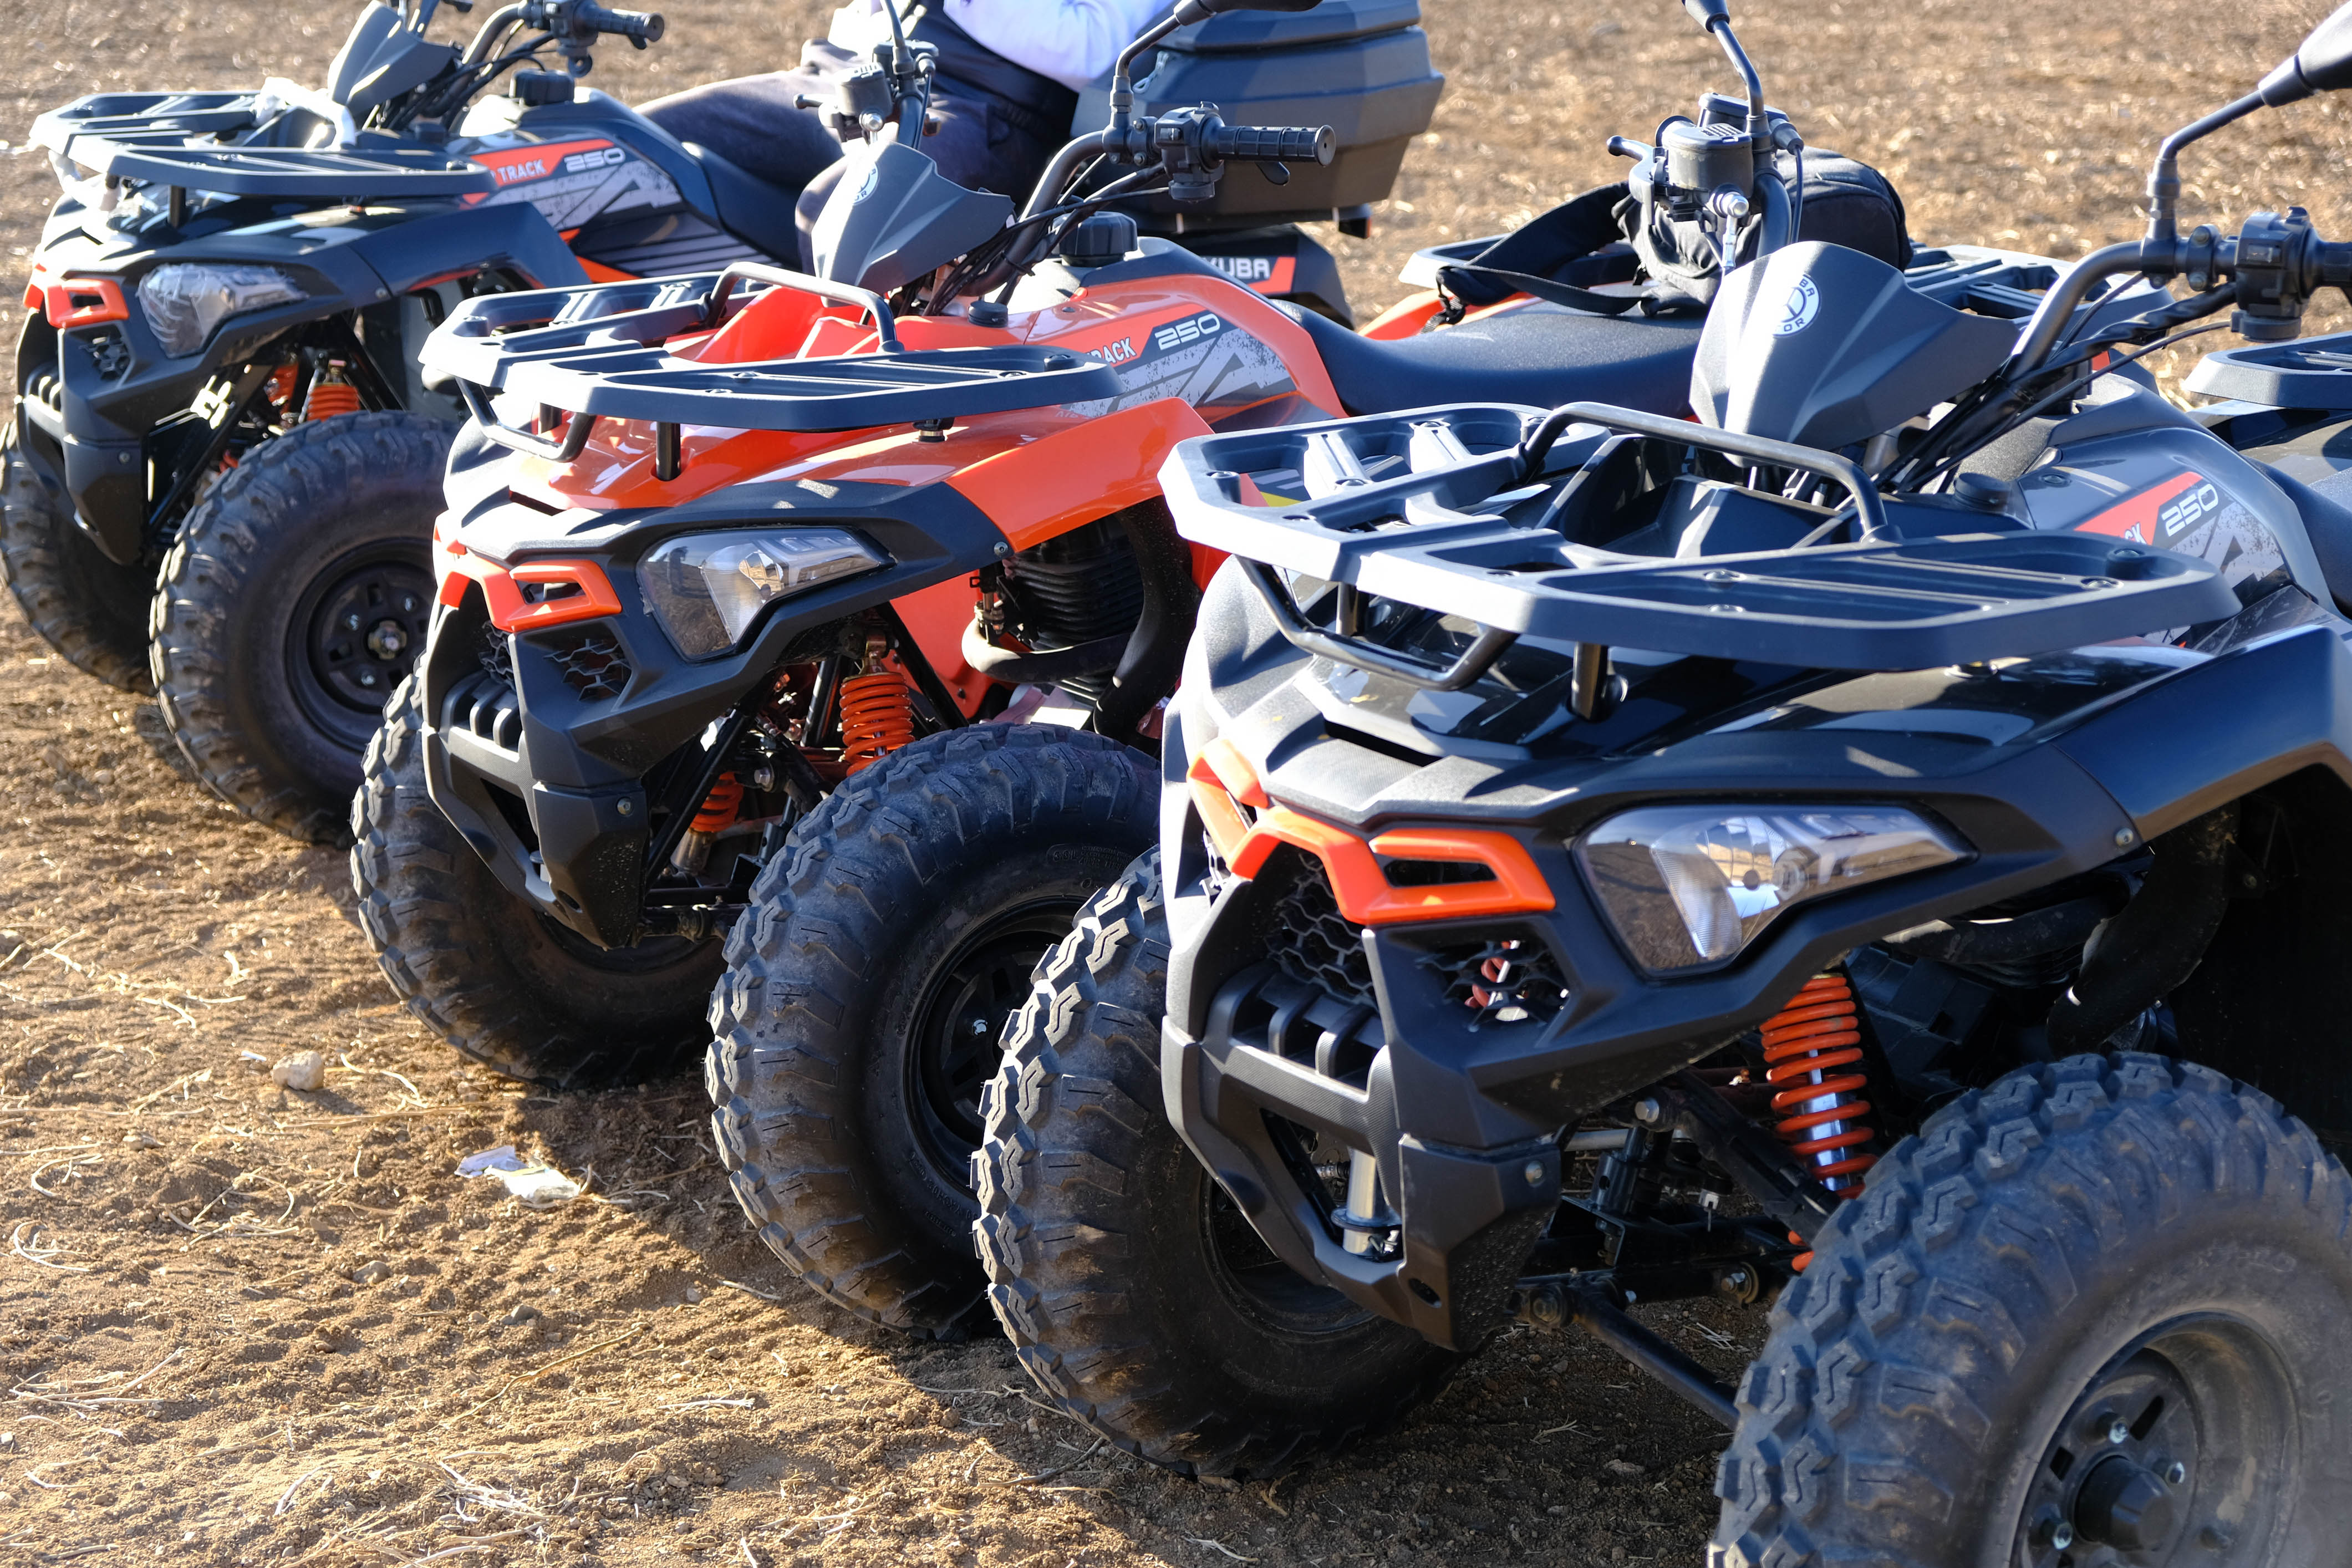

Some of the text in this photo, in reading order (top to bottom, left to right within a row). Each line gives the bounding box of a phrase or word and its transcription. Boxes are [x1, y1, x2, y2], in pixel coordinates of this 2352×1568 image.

[497, 159, 546, 183] TRACK
[563, 147, 625, 173] 250
[1154, 313, 1220, 350] 250
[2161, 483, 2218, 537] 250
